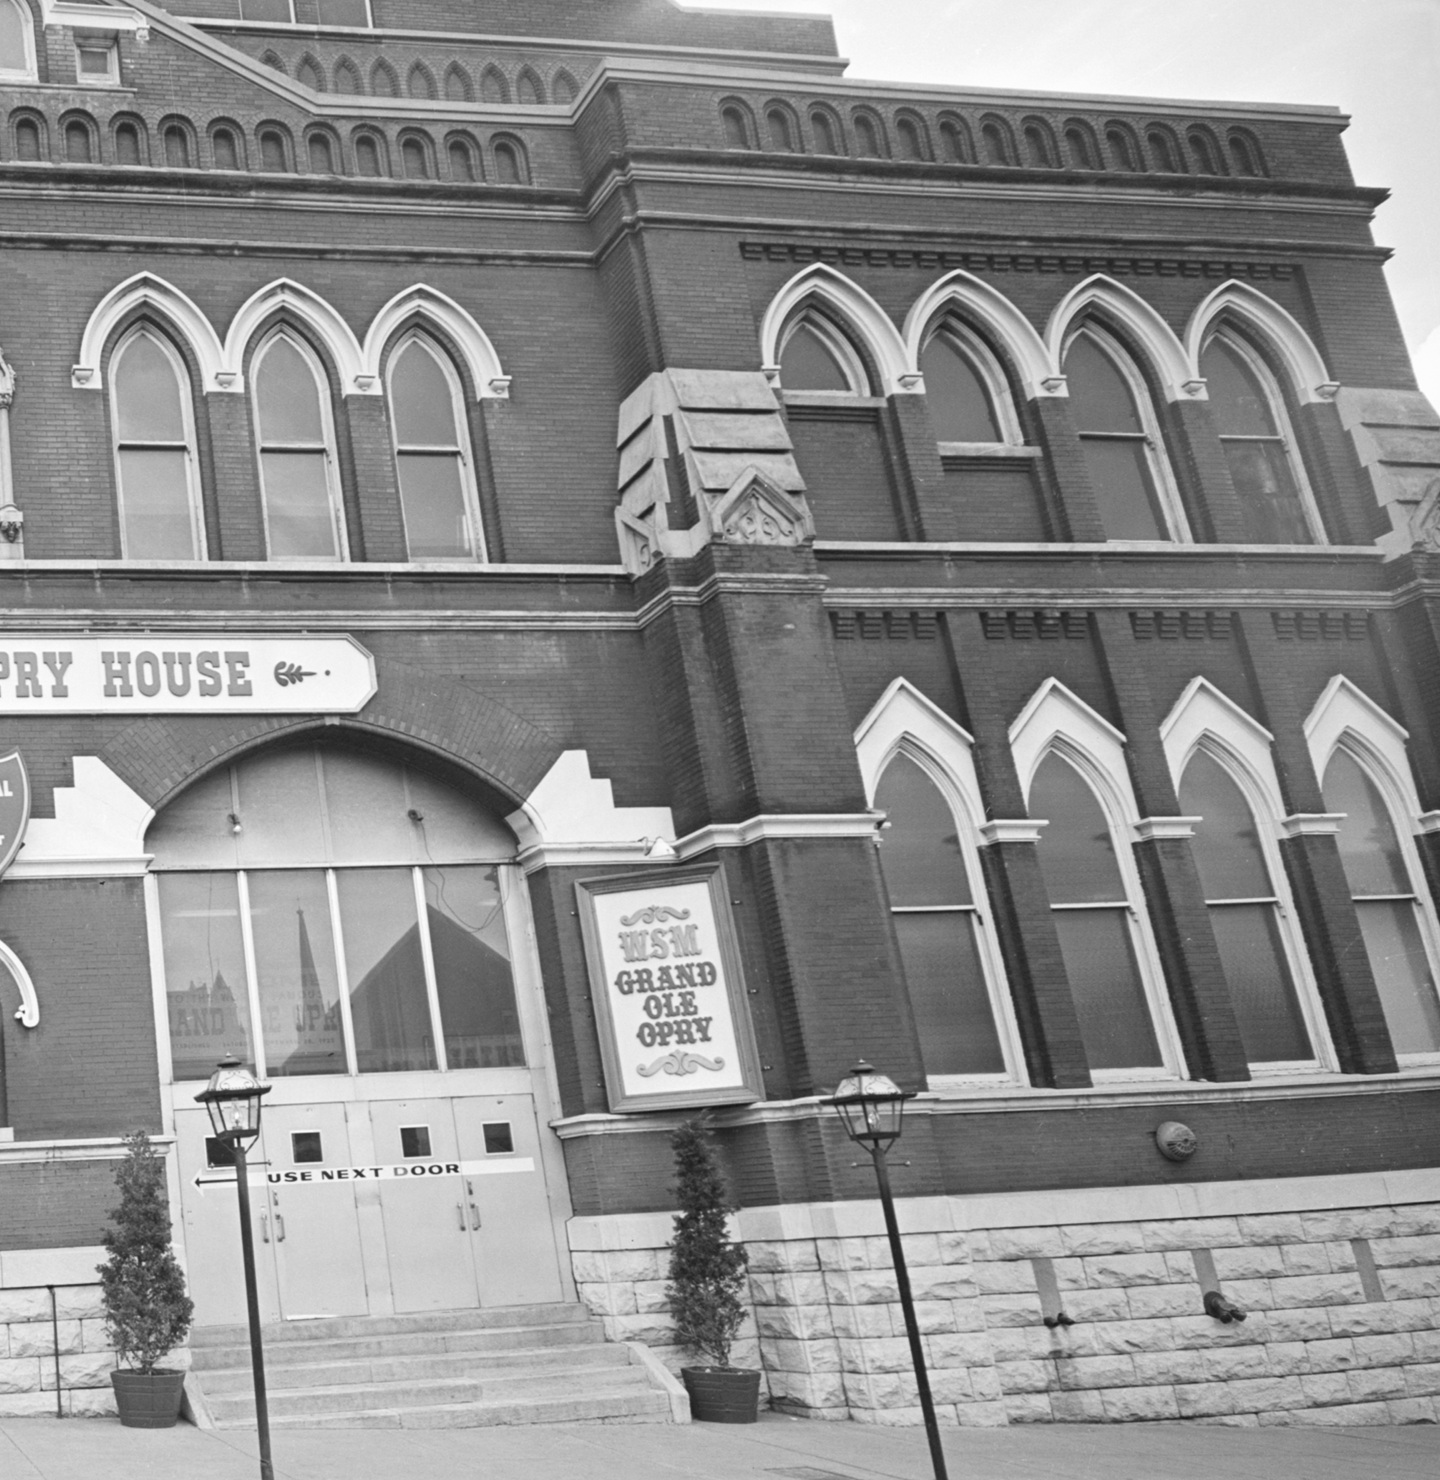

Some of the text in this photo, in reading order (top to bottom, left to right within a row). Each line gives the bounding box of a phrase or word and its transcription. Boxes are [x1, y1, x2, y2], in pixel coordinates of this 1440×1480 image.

[101, 650, 253, 697] HOUSE
[618, 923, 702, 963] WSM
[614, 961, 717, 995] GRAND
[643, 991, 699, 1019] OLE
[636, 1016, 713, 1047] OPRY
[267, 1163, 461, 1184] USE NEXT DOOR
